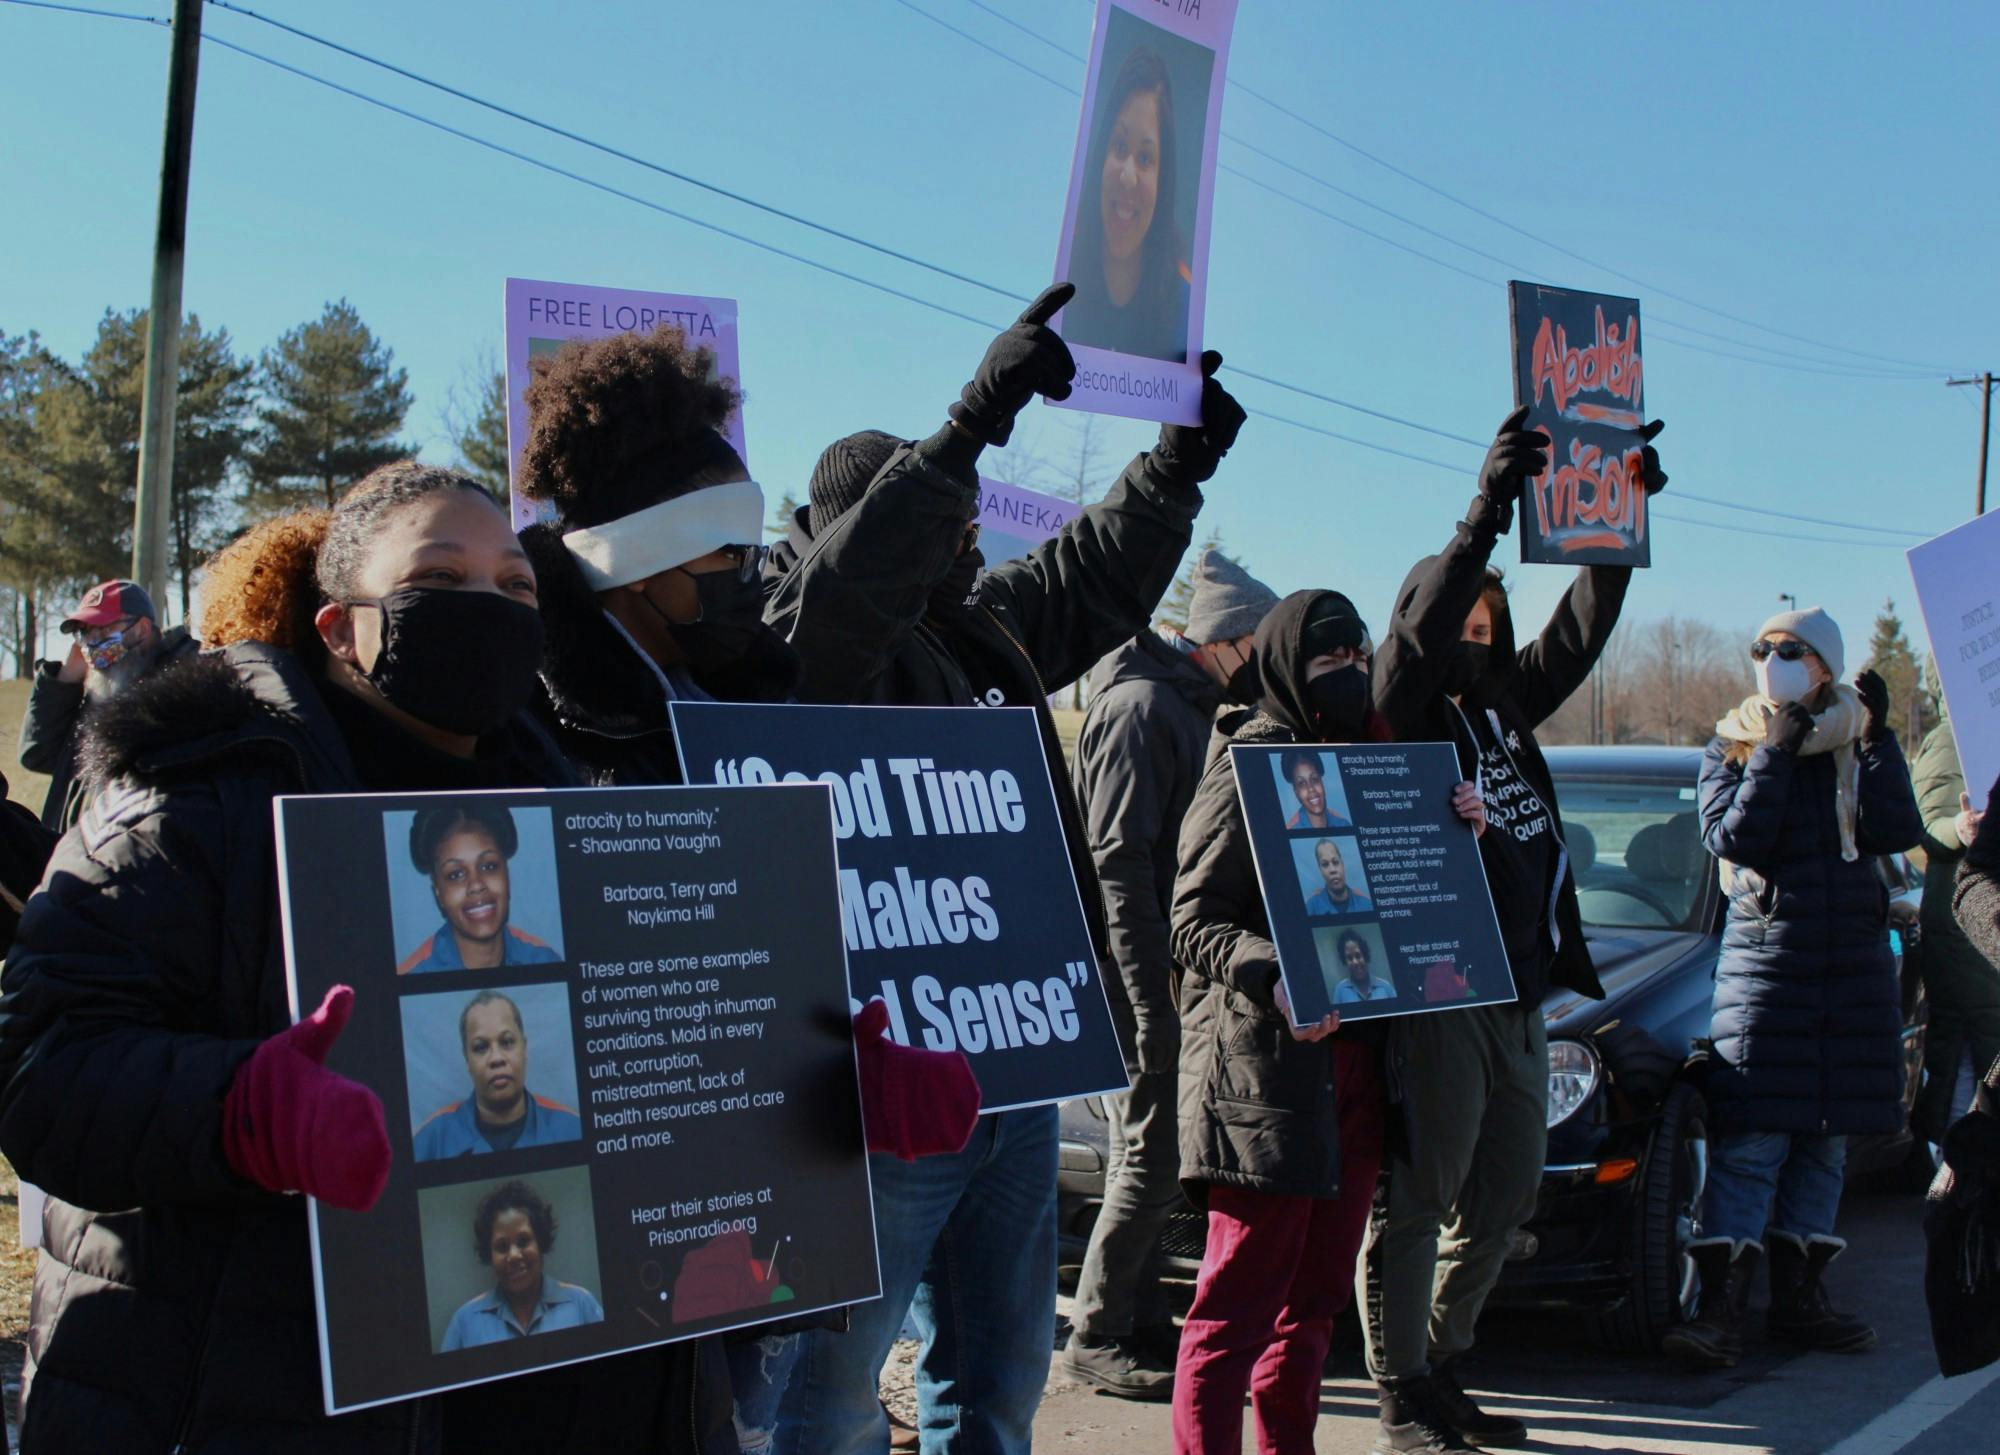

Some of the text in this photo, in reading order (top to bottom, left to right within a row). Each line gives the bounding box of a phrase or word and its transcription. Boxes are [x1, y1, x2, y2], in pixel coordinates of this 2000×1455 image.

[530, 297, 591, 327] FREE
[1532, 304, 1641, 417] Abolish
[1531, 424, 1646, 545] Prison
[979, 490, 1063, 532] ANEKA
[887, 758, 1026, 836] Time
[565, 811, 622, 832] atrocity
[626, 812, 642, 828] to
[581, 838, 661, 854] Shawanna
[664, 833, 721, 854] Vaughn
[603, 879, 737, 902] Barbara, Terry and
[628, 903, 715, 928] Naykima Hill
[579, 949, 770, 978] These are some examples
[581, 978, 720, 1004] of women who are
[584, 996, 776, 1029] surviving through inhuman
[586, 1021, 764, 1054] conditions. Mold in every
[589, 1052, 703, 1079] unit, corruption,
[591, 1068, 745, 1104] mistreatment, lack of
[593, 1090, 785, 1129] health resources and care
[596, 1130, 675, 1154] and more.
[632, 1186, 773, 1224] Hear their stories at
[648, 1215, 757, 1247] Prisonradio.org
